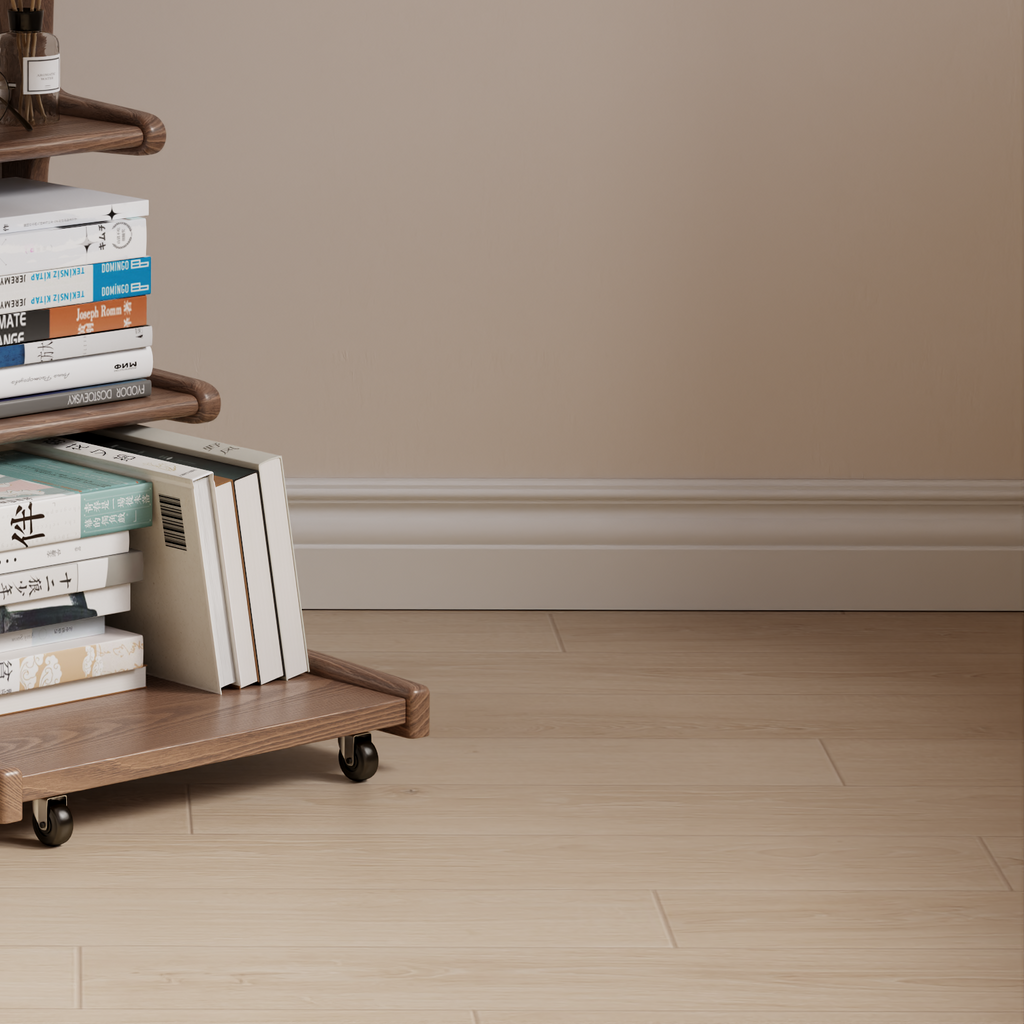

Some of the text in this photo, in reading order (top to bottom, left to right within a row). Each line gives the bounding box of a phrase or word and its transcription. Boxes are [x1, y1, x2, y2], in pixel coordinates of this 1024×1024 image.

[0, 275, 26, 286] JEREMY
[0, 298, 26, 309] JEREMY
[76, 305, 99, 322] Joseph
[101, 304, 123, 317] Romm
[67, 384, 145, 405] FYODOR DOSTOEVSKY
